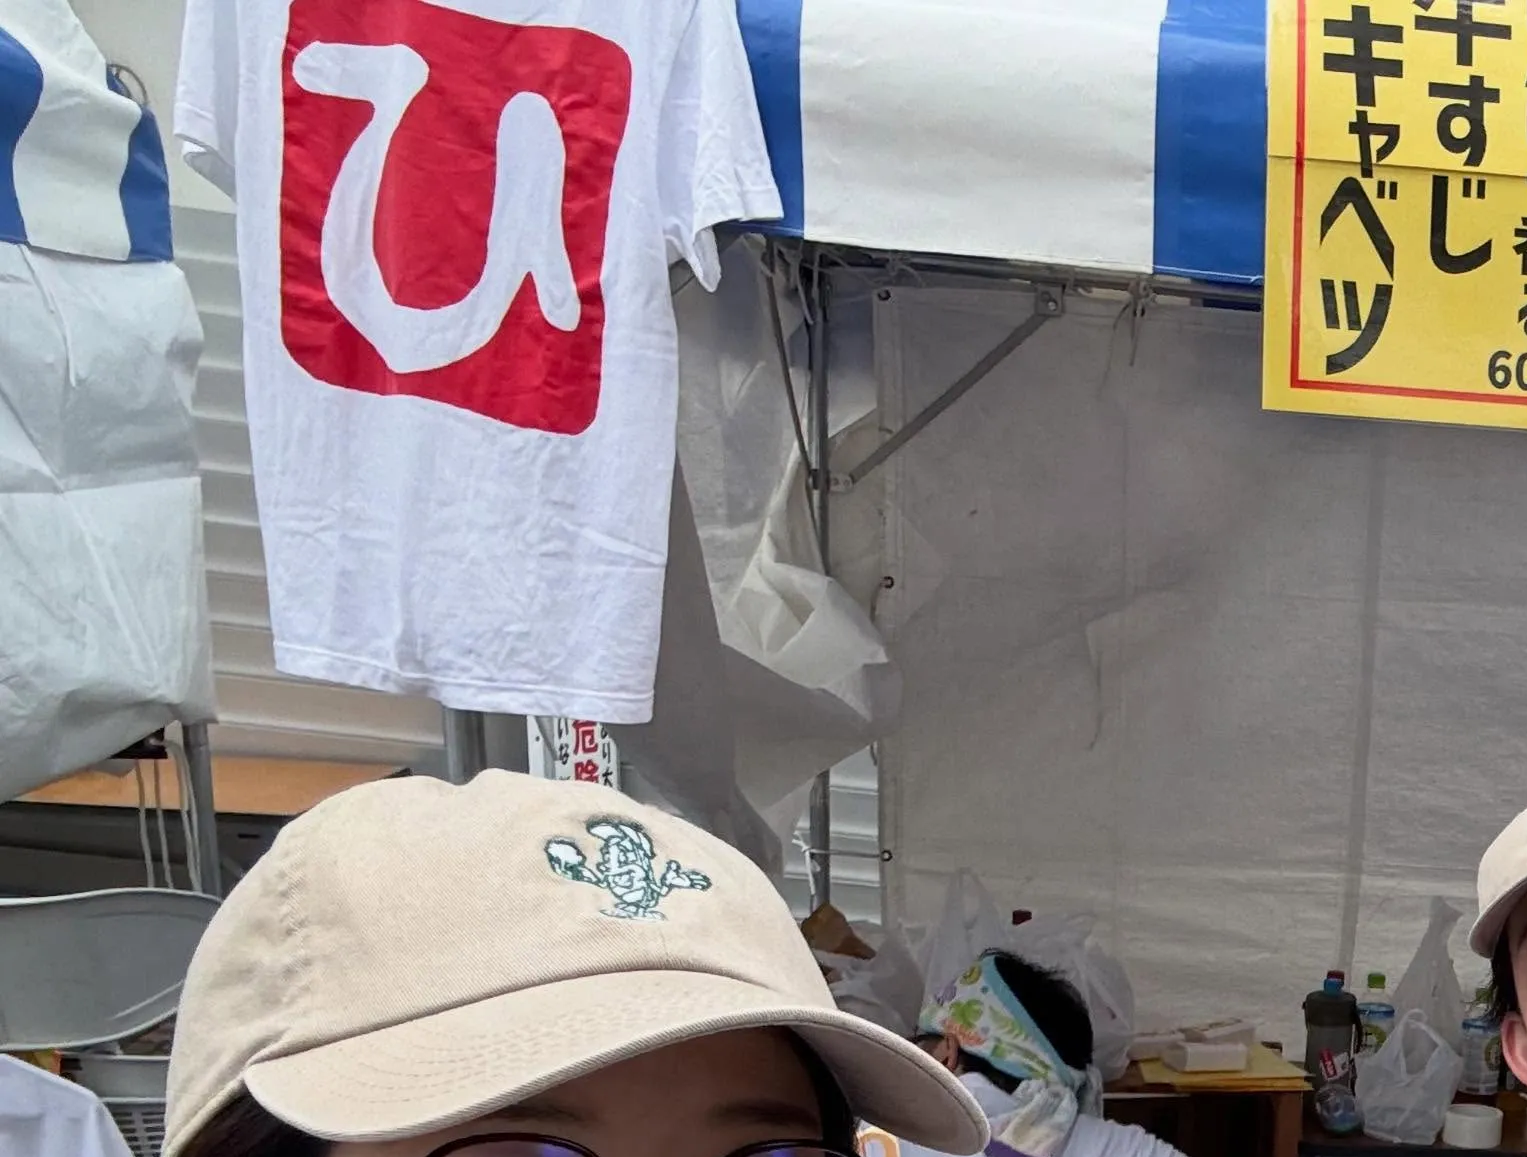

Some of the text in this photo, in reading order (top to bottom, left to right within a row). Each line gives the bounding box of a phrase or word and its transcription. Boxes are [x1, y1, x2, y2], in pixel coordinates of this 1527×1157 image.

[1320, 5, 1404, 376] キャベツ
[1413, 0, 1512, 274] 牛すじ
